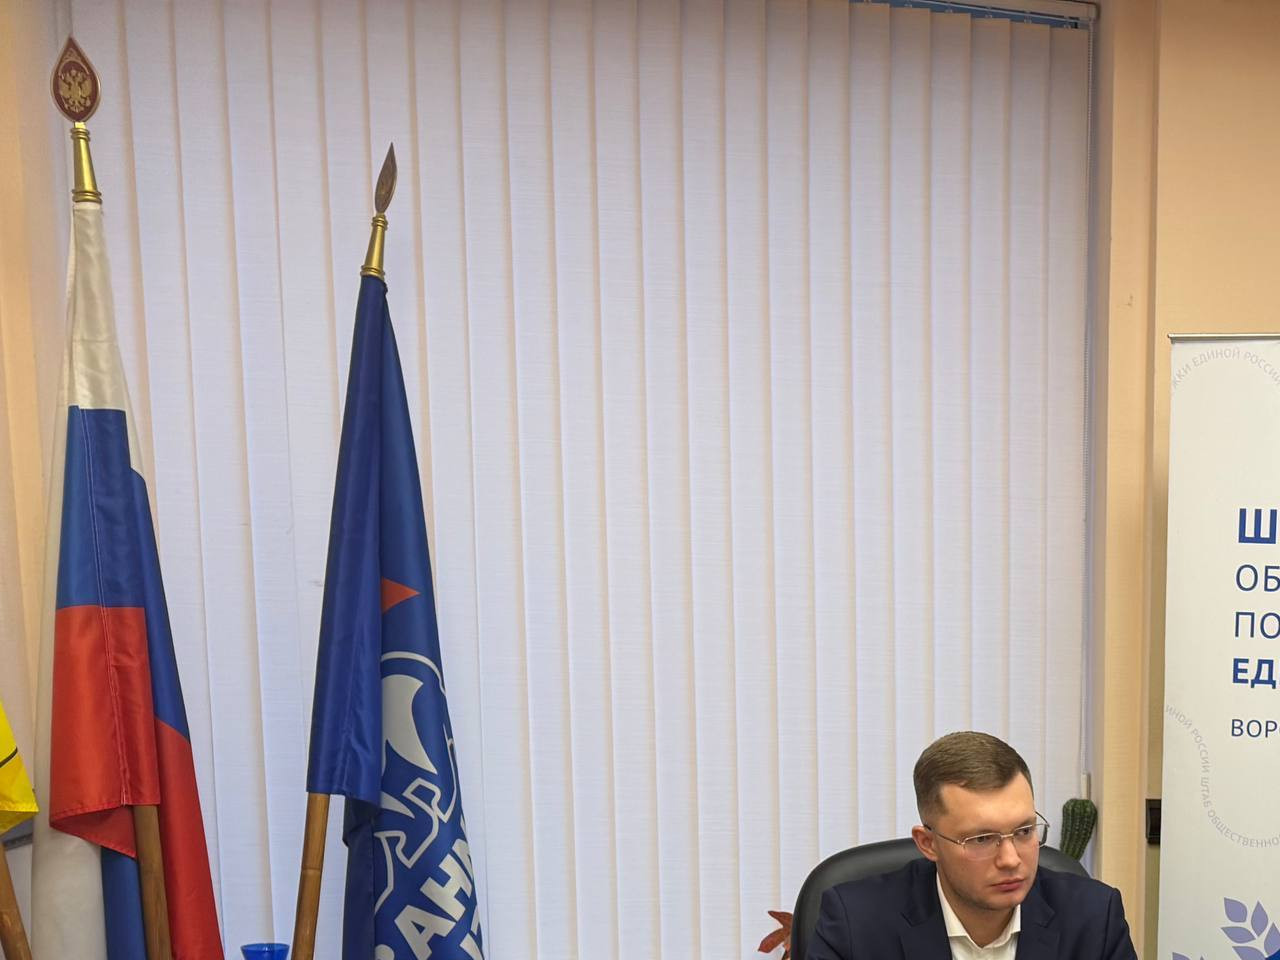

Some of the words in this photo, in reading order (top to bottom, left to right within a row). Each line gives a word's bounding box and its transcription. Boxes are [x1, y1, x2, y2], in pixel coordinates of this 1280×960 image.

[1193, 346, 1240, 367] ЕДИНОЙ
[1191, 728, 1211, 774] РОССИИ
[1200, 776, 1212, 808] ШТАБ
